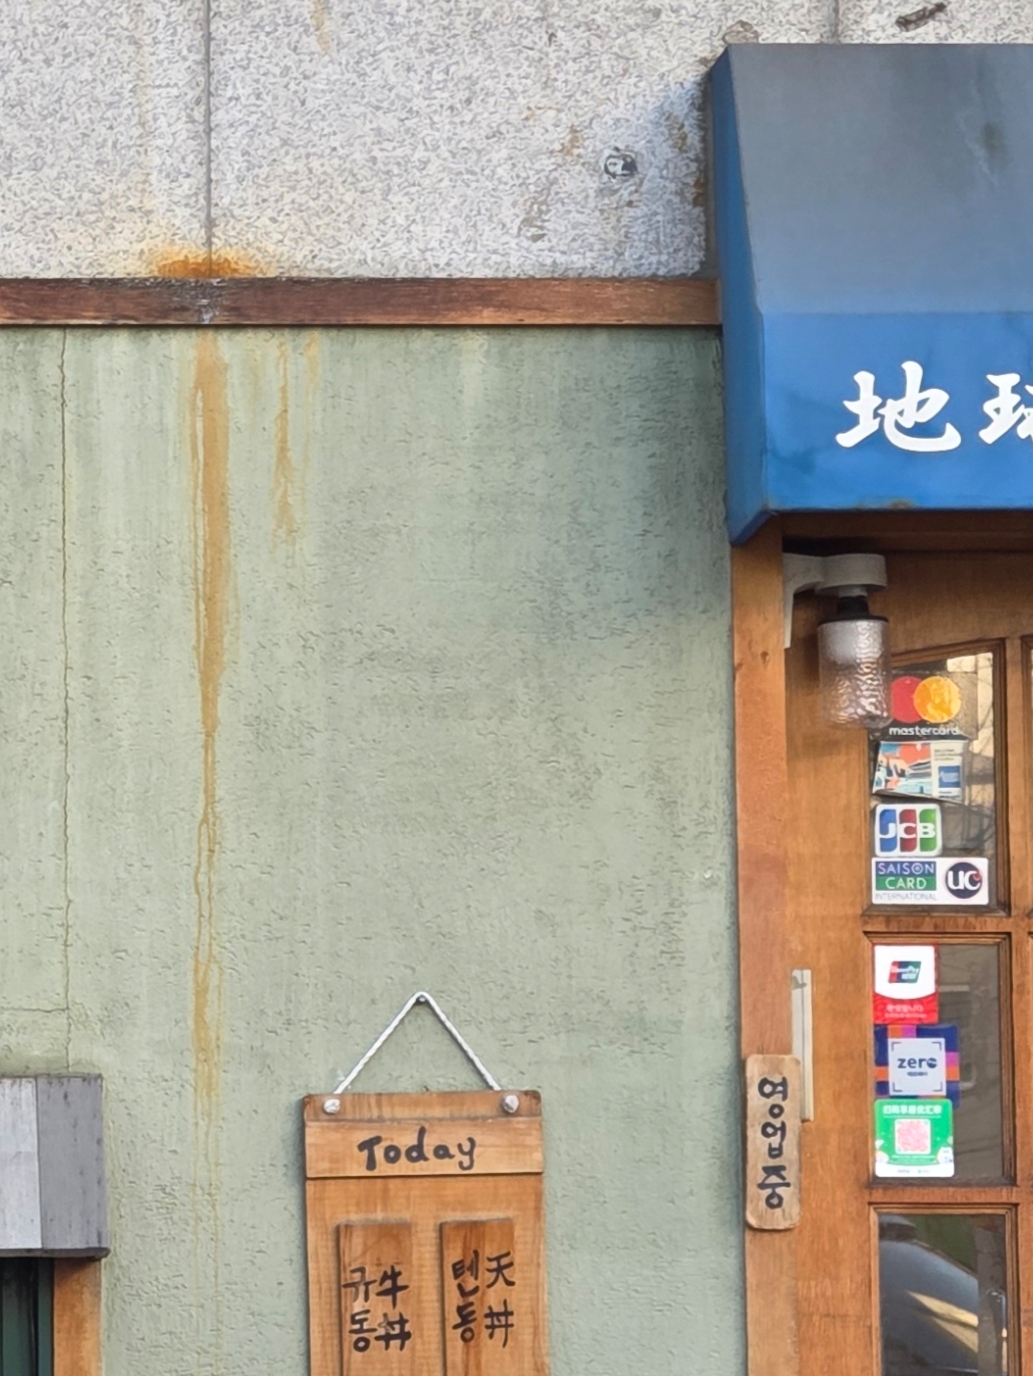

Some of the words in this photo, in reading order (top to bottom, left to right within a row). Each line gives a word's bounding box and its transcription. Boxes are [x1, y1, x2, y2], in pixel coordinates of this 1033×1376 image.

[889, 725, 959, 736] mastercard
[879, 822, 936, 839] JCB
[878, 862, 935, 875] SAISON
[885, 877, 927, 890] CARD
[948, 870, 981, 890] UC
[875, 893, 937, 901] INTERNATIONAL
[897, 1057, 938, 1069] zero
[357, 1126, 477, 1172] Today
[757, 1076, 791, 1210] 영업중
[451, 1249, 480, 1343] 텐동
[484, 1250, 516, 1348] 天丼
[342, 1265, 378, 1353] 규동
[374, 1264, 412, 1352] 牛丼
